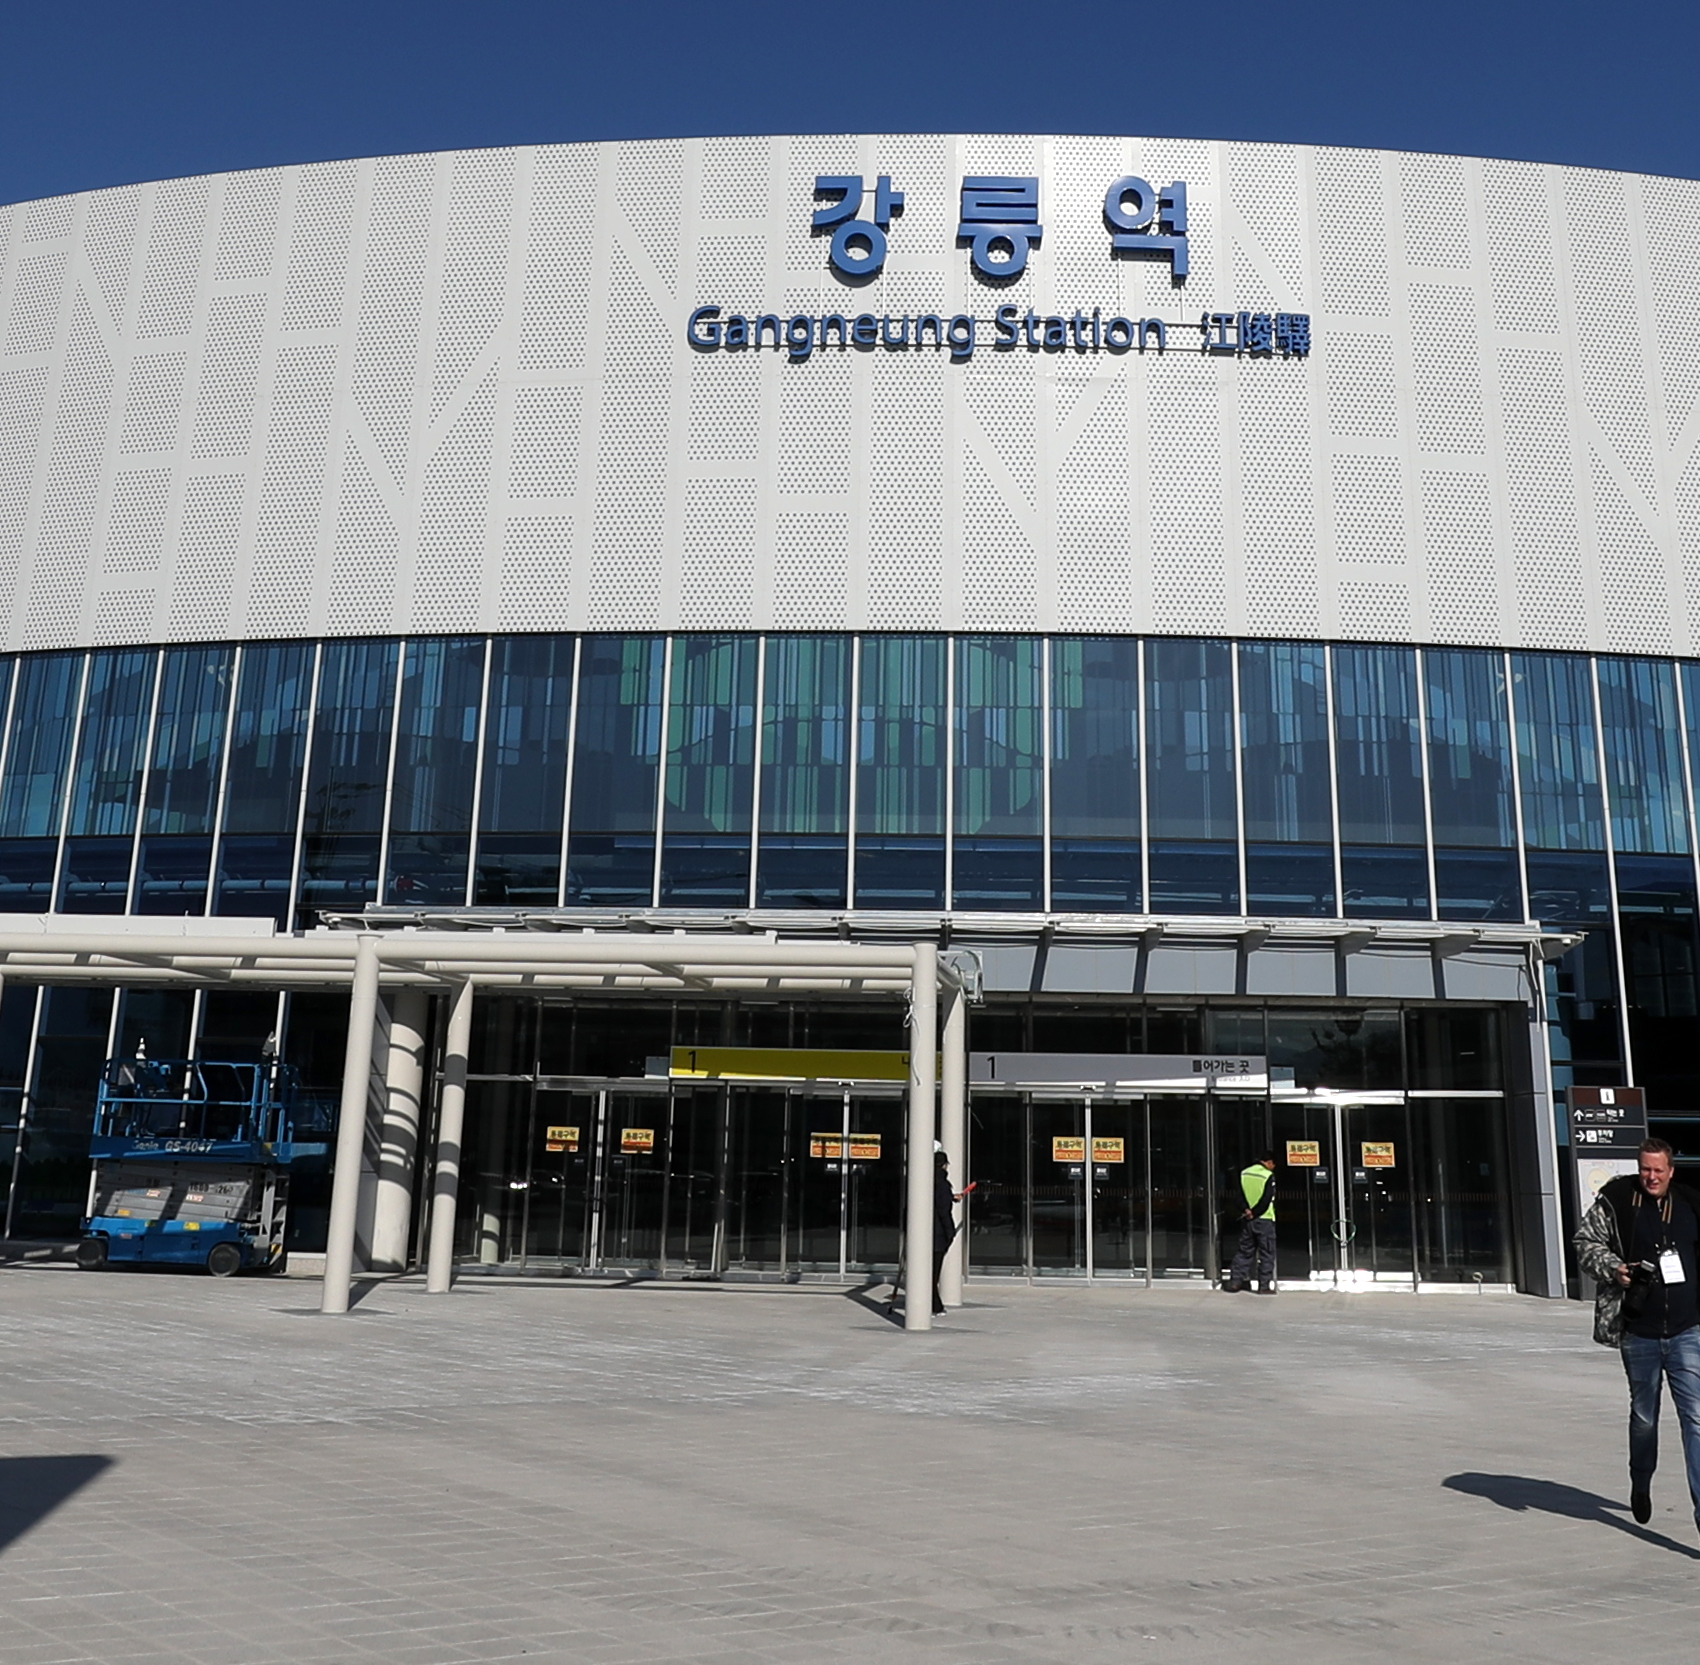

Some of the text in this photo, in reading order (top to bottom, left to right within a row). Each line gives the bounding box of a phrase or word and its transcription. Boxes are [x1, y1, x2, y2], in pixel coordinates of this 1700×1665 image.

[812, 175, 1188, 278] 강릉역
[687, 305, 1311, 357] Gangneung Station 江陵驛
[688, 1050, 697, 1073] 1
[987, 1056, 996, 1079] 1
[1239, 1060, 1250, 1073] 곳
